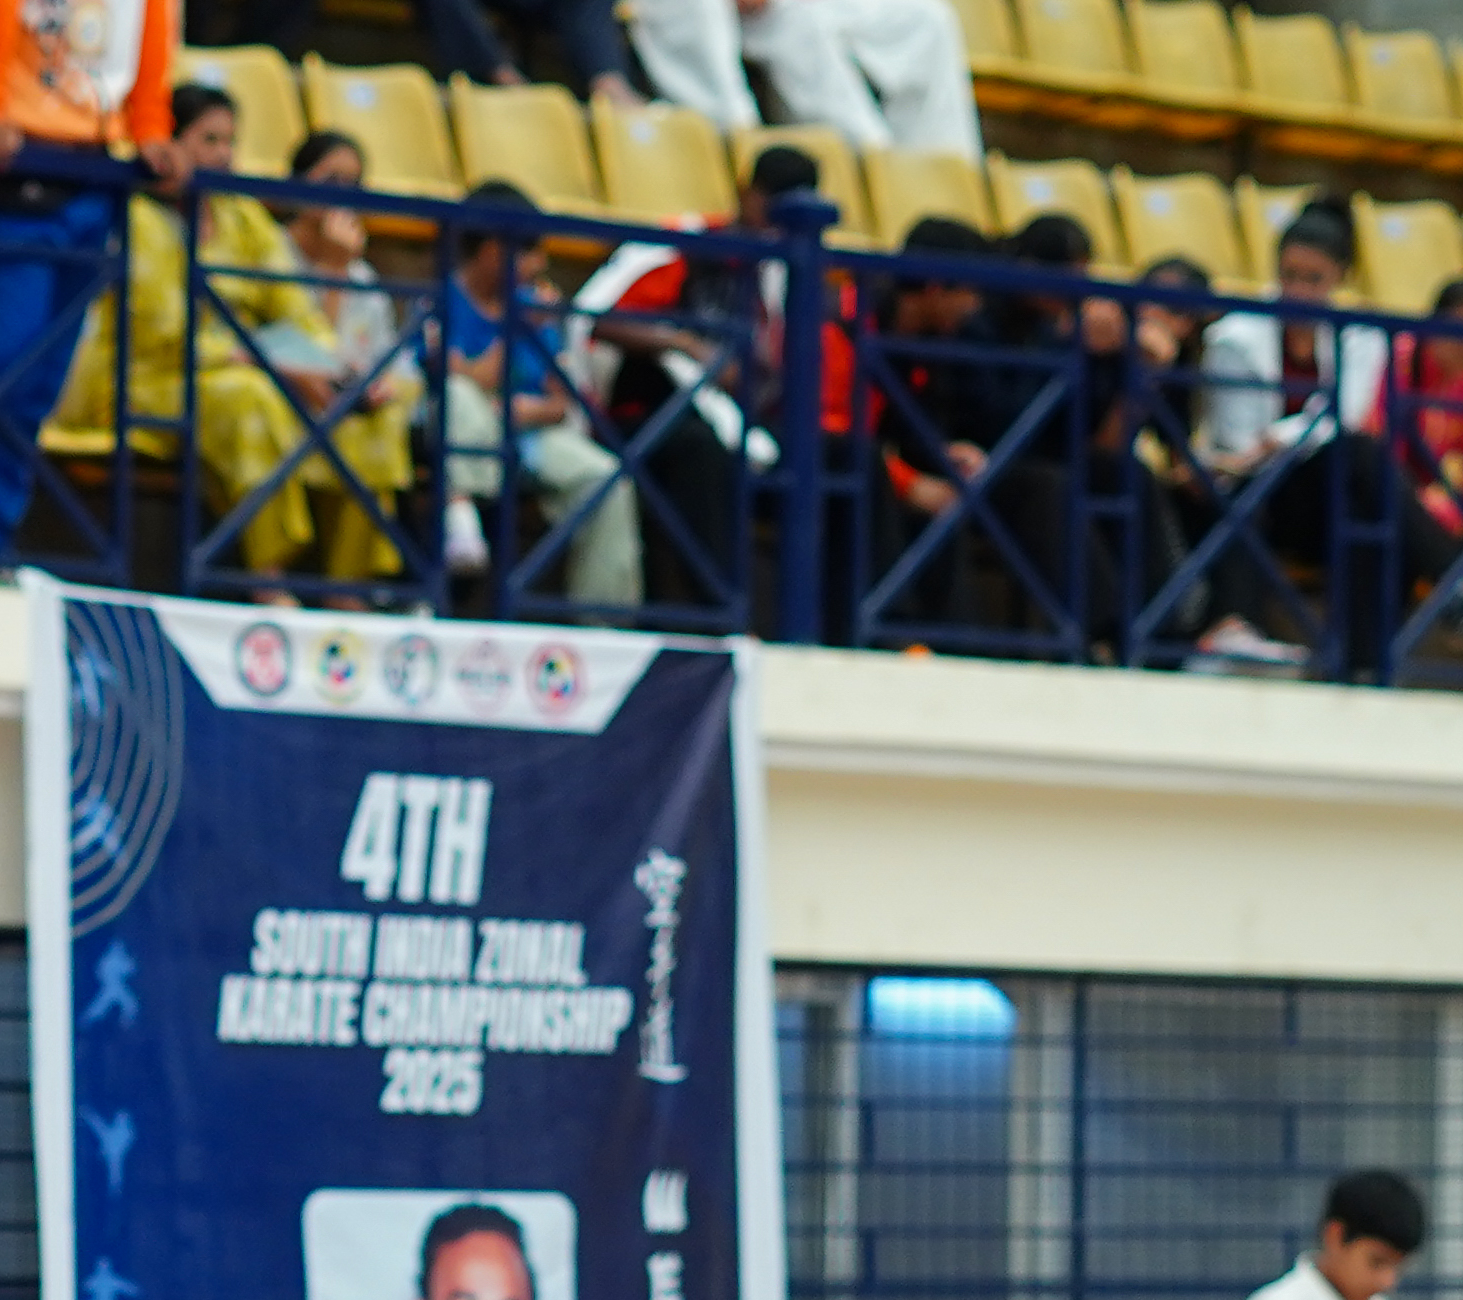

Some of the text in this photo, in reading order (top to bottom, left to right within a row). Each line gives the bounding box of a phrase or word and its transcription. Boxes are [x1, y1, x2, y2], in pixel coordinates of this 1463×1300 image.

[339, 771, 494, 906] 4TH
[250, 907, 588, 987] SOUTH INDIA ZONAL
[217, 972, 634, 1055] KARATE CHAMPIONSHIP
[379, 1047, 484, 1117] 2025
